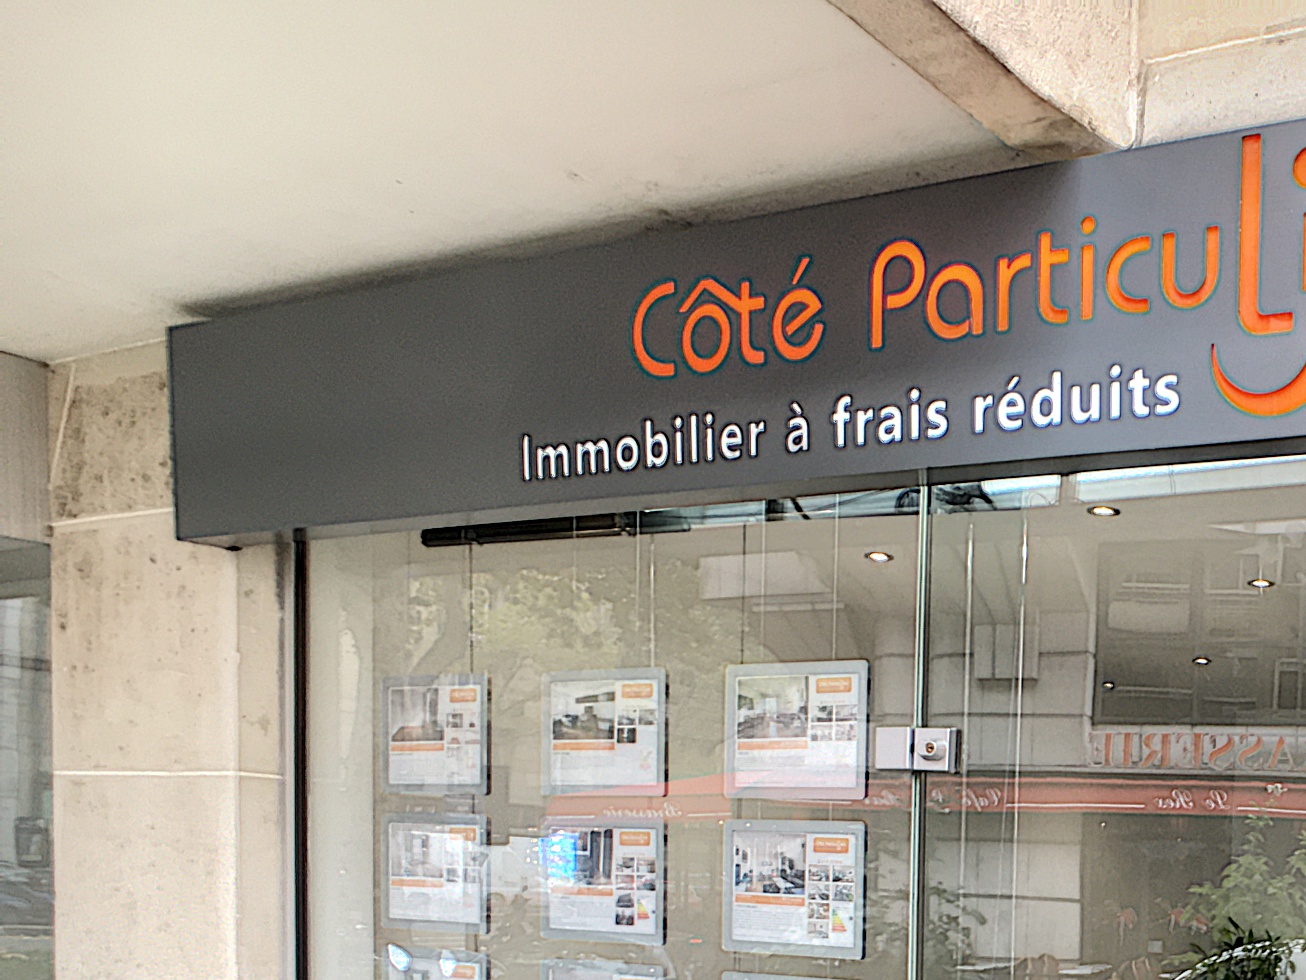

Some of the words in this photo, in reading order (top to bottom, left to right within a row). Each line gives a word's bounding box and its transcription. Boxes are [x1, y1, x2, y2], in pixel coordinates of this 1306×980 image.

[631, 256, 825, 378] Côté
[521, 411, 767, 482] Immobilier
[786, 401, 811, 453] à
[832, 388, 949, 449] frais
[972, 364, 1182, 435] réduits
